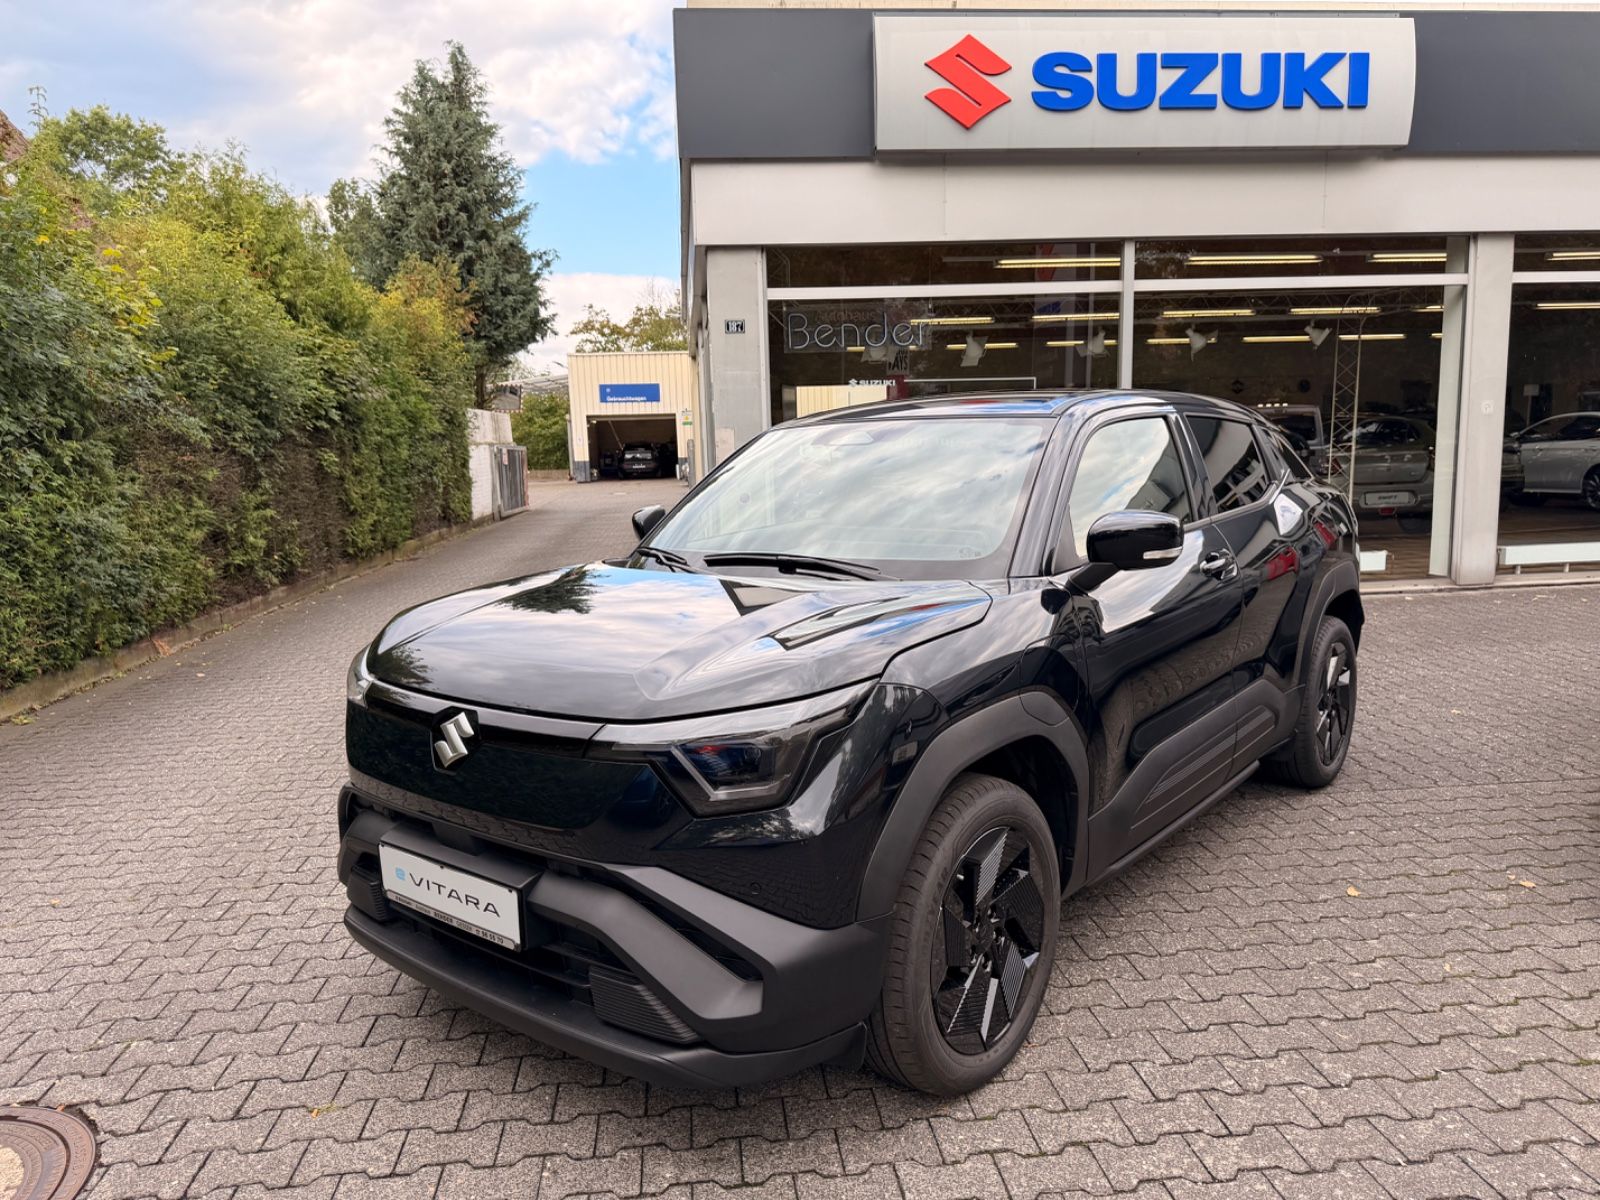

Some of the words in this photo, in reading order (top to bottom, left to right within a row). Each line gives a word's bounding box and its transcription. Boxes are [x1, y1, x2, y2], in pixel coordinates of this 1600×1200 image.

[1031, 51, 1370, 111] SUZUKI
[728, 321, 743, 333] 187
[788, 311, 927, 349] Bender
[858, 379, 896, 387] SUZUKI
